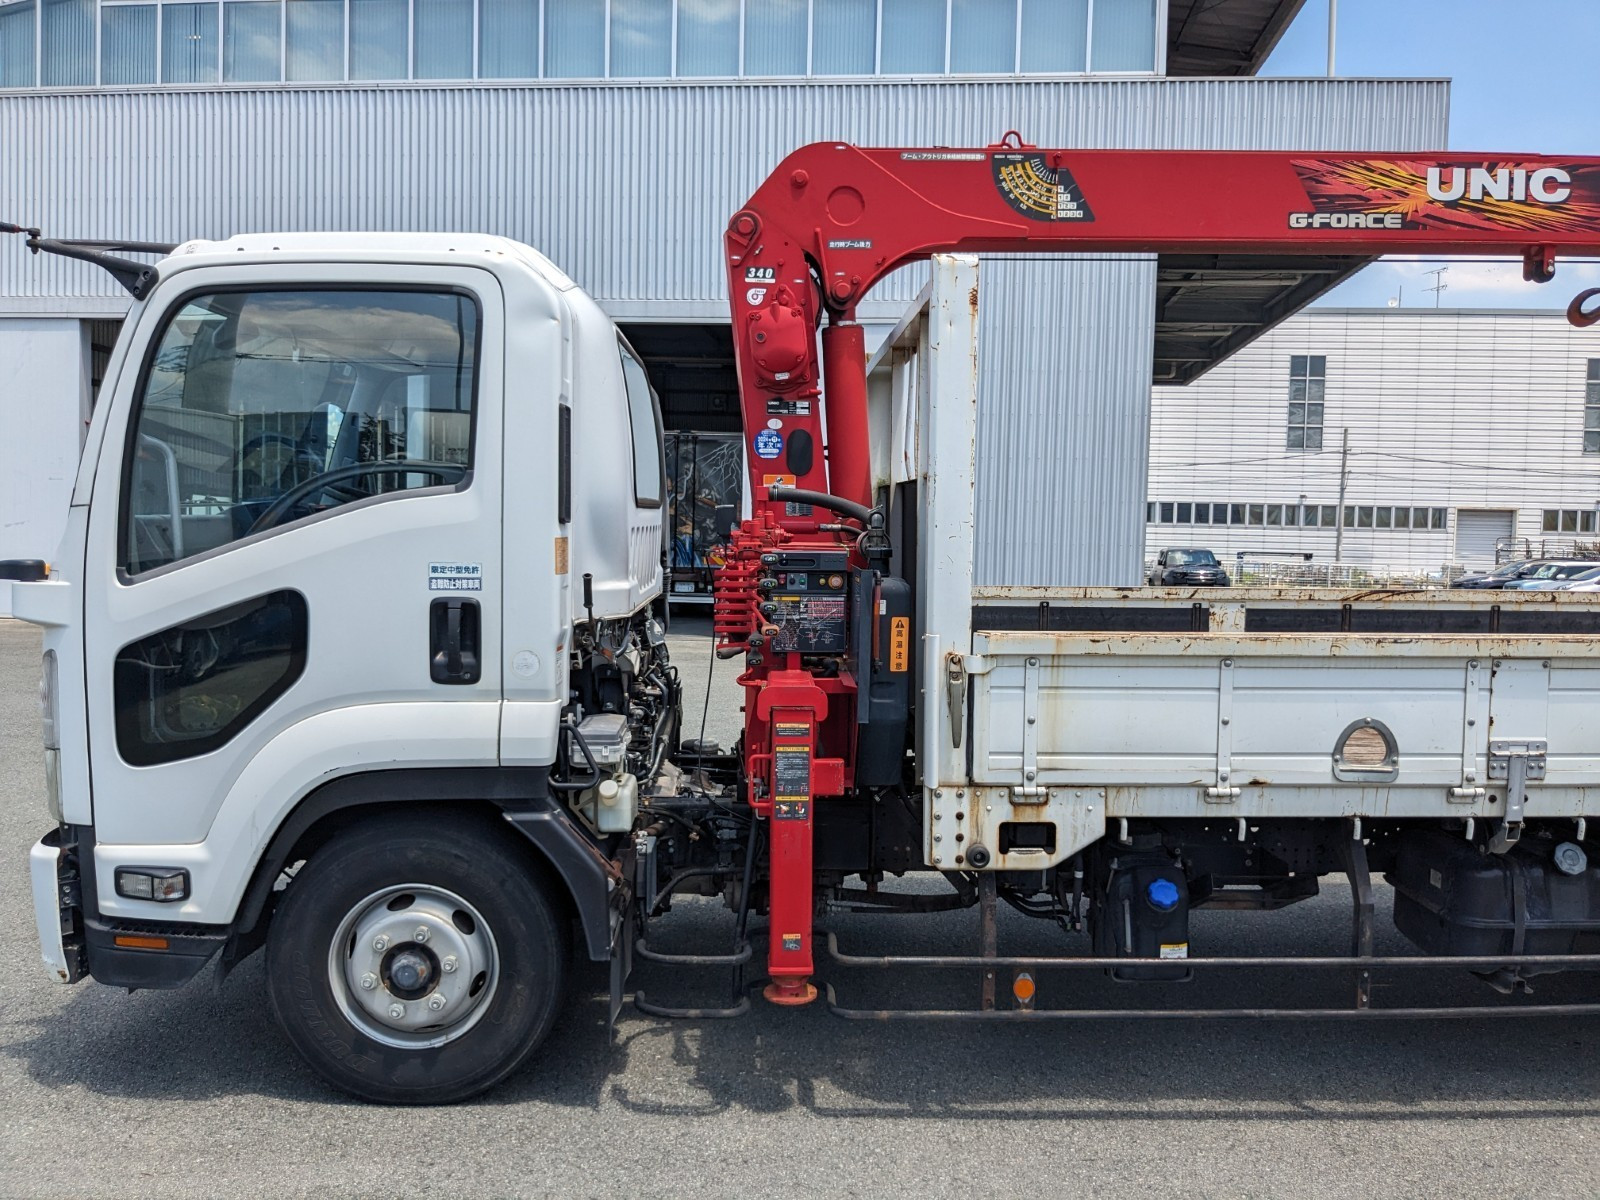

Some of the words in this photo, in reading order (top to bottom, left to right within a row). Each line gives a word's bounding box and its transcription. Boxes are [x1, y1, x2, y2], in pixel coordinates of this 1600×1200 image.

[1426, 167, 1571, 203] UNIC
[1289, 213, 1402, 228] G-FORCE
[748, 268, 773, 278] 340
[431, 566, 480, 574] 限定中型免許
